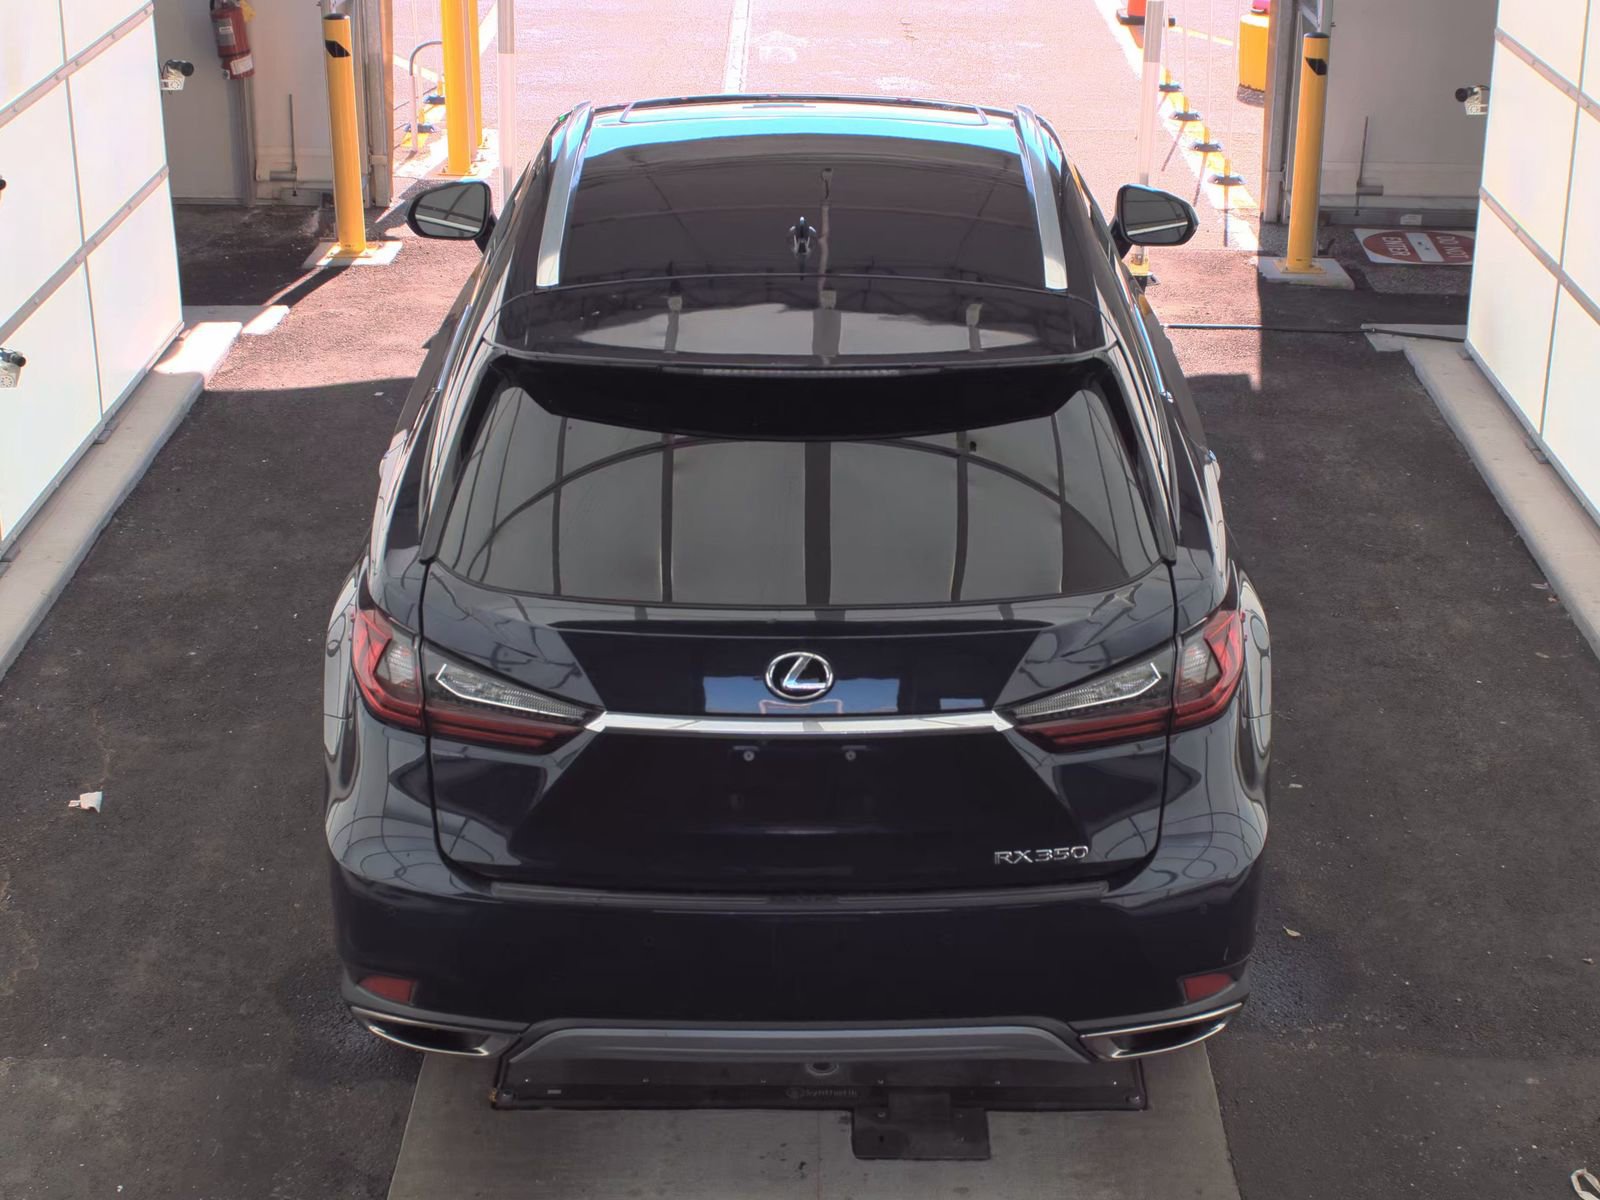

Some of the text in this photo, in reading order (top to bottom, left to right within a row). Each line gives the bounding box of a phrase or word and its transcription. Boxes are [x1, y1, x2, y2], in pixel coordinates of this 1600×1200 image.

[1382, 236, 1411, 256] ENTER
[1436, 235, 1469, 259] DO NOT
